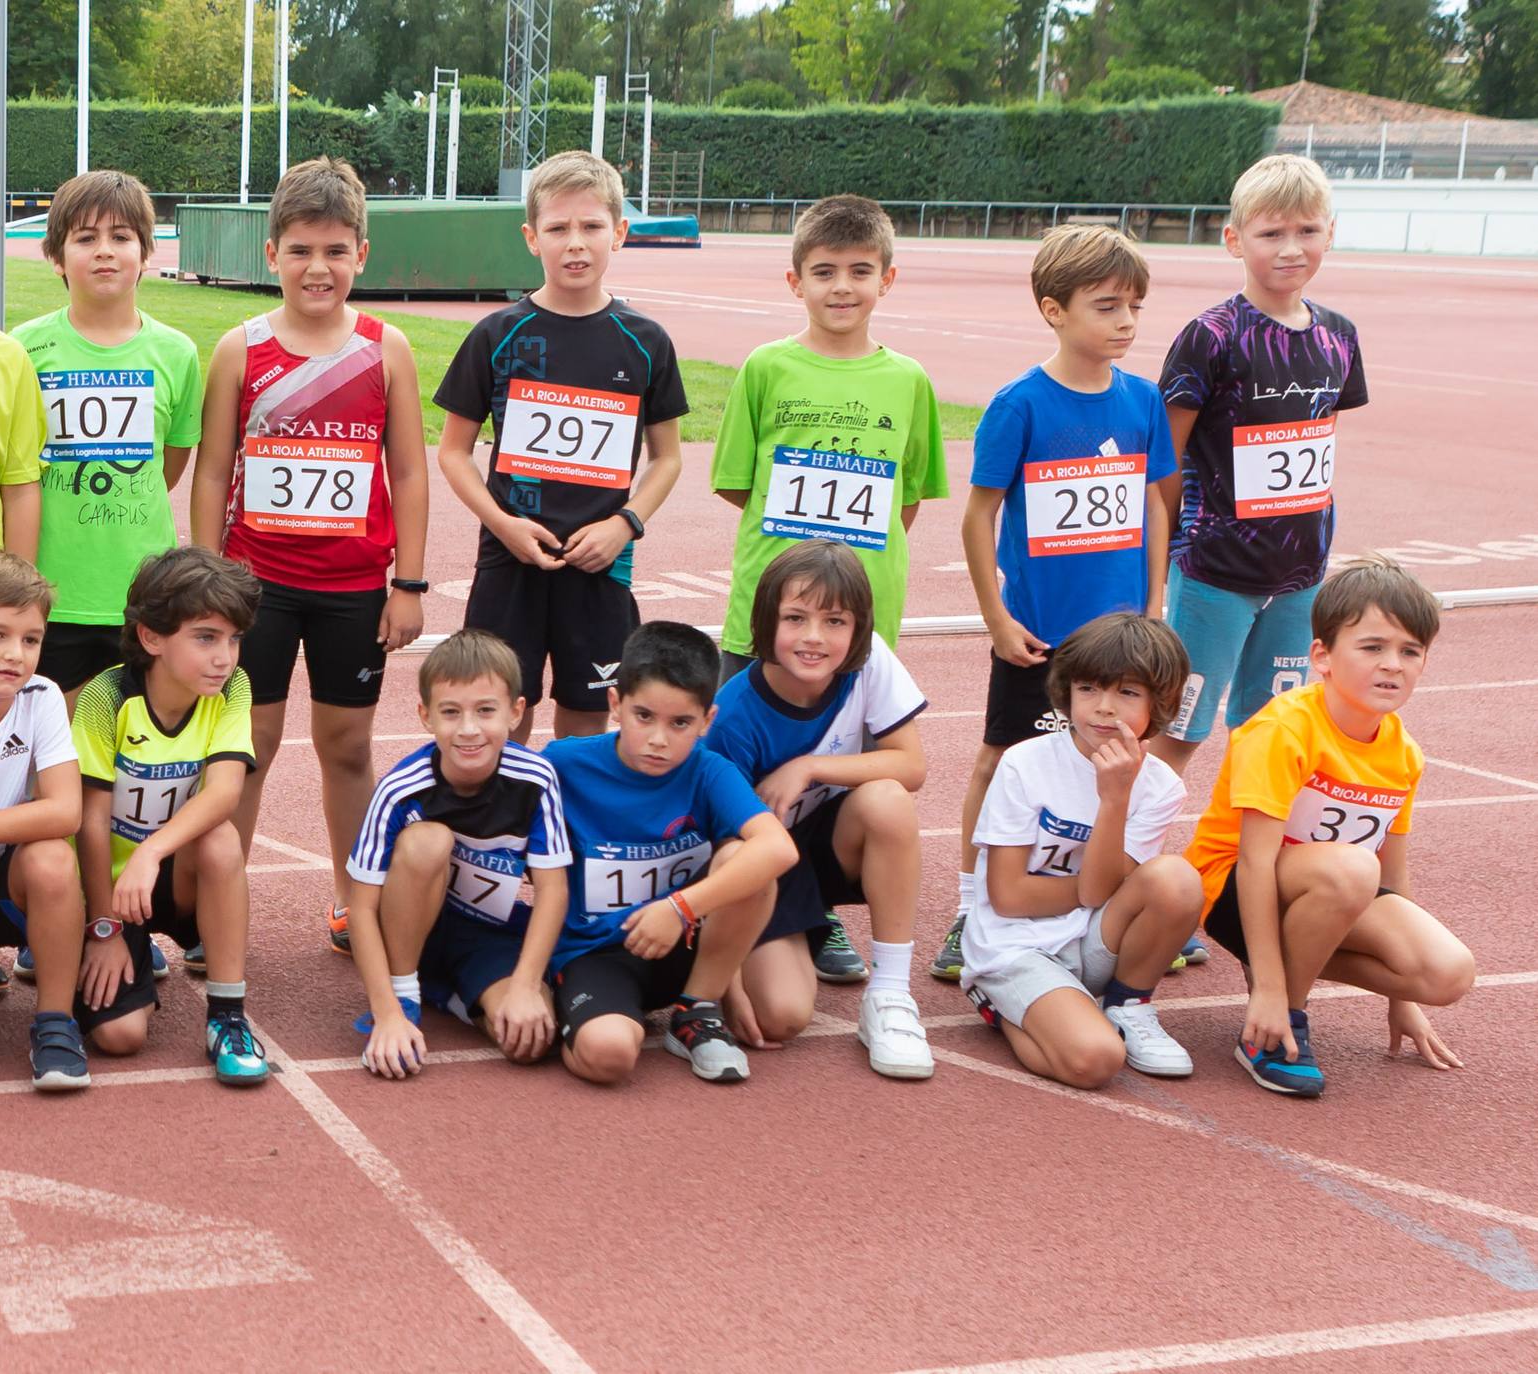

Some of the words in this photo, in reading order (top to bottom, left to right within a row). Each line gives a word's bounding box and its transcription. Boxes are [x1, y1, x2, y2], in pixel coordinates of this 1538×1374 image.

[67, 371, 146, 387] HEMAFIX
[521, 387, 534, 399] LA
[536, 389, 571, 404] RIOJA
[573, 394, 625, 412] ATLETISMO
[777, 398, 811, 410] Logroño
[50, 395, 138, 440] 107
[782, 410, 821, 423] Carrera
[829, 411, 869, 427] Familia
[525, 411, 615, 461] 297
[1247, 432, 1263, 443] LA
[1265, 429, 1299, 442] RIOJA
[54, 449, 75, 457] Central
[75, 447, 114, 457] Logroñesa
[114, 447, 124, 456] de
[125, 447, 153, 456] Pinturas
[257, 444, 269, 455] LA
[271, 444, 304, 457] RIOJA
[307, 446, 363, 460] ATLETISMO
[511, 458, 616, 481] www.lariojaatletismo.com
[811, 452, 889, 477] HEMAFIX
[1039, 469, 1054, 480] LA
[1057, 465, 1091, 478] RIOJA
[1267, 444, 1330, 491] 326
[270, 466, 354, 511] 378
[784, 475, 875, 526] 114
[1054, 483, 1128, 530] 288
[77, 502, 149, 527] CAMPUS
[257, 517, 355, 530] www.lariojaatletismo.com
[776, 522, 804, 535] Central
[805, 527, 845, 541] Logroñesa
[846, 532, 857, 541] de
[1273, 656, 1310, 668] NEVER
[1184, 686, 1198, 707] STOP
[0, 745, 30, 760] adidas
[150, 762, 199, 779] HEMA
[1313, 777, 1329, 792] LA
[1331, 786, 1368, 803] RIOJA
[119, 825, 146, 839] Central
[626, 831, 703, 859] HEMAFIX
[606, 856, 694, 908] 116
